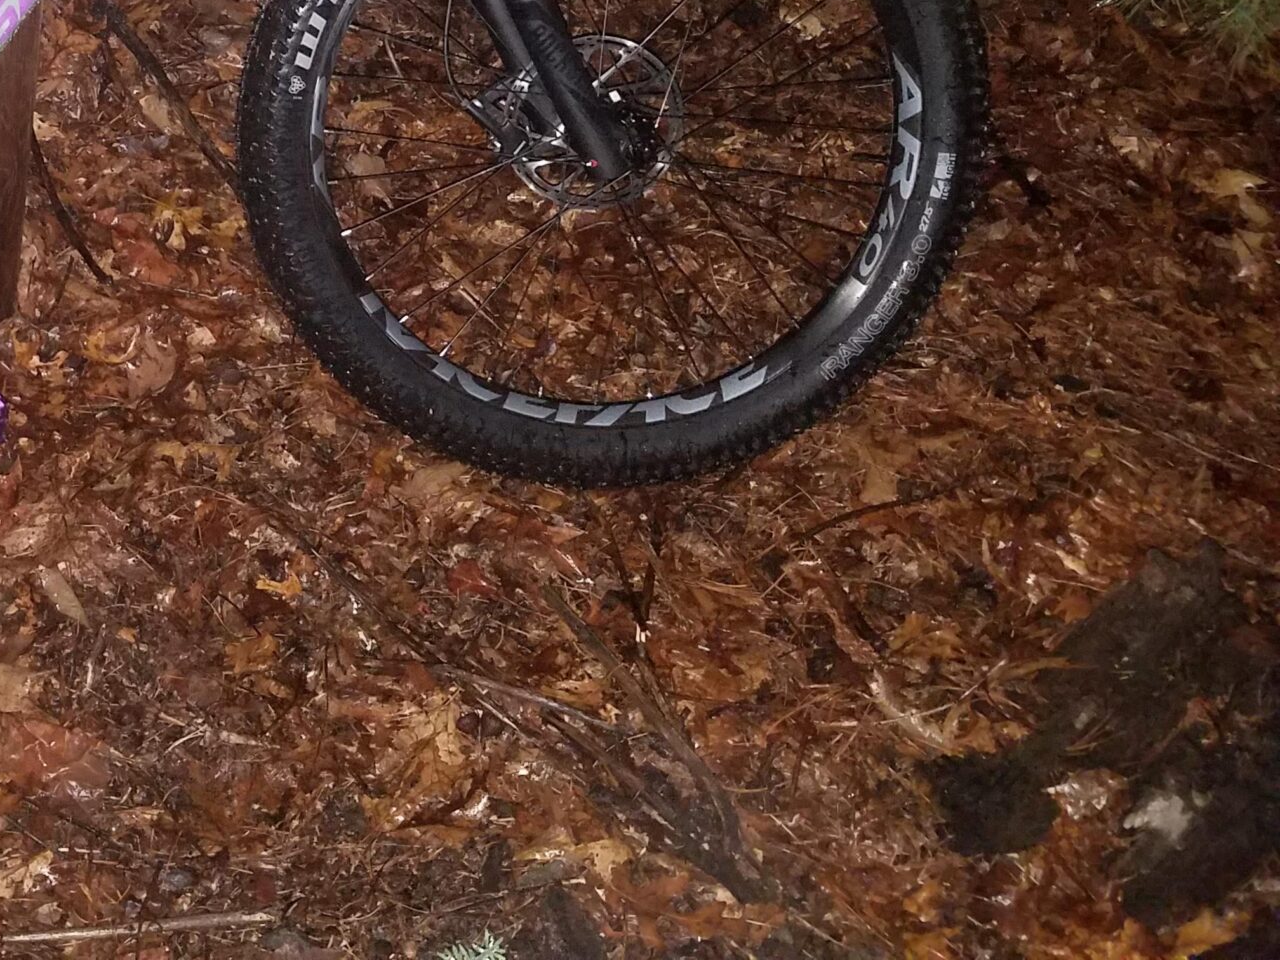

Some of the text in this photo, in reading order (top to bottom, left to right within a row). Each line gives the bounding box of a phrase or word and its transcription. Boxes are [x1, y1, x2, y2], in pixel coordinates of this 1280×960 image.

[859, 51, 923, 278] AR 40
[820, 280, 910, 381] RANGER
